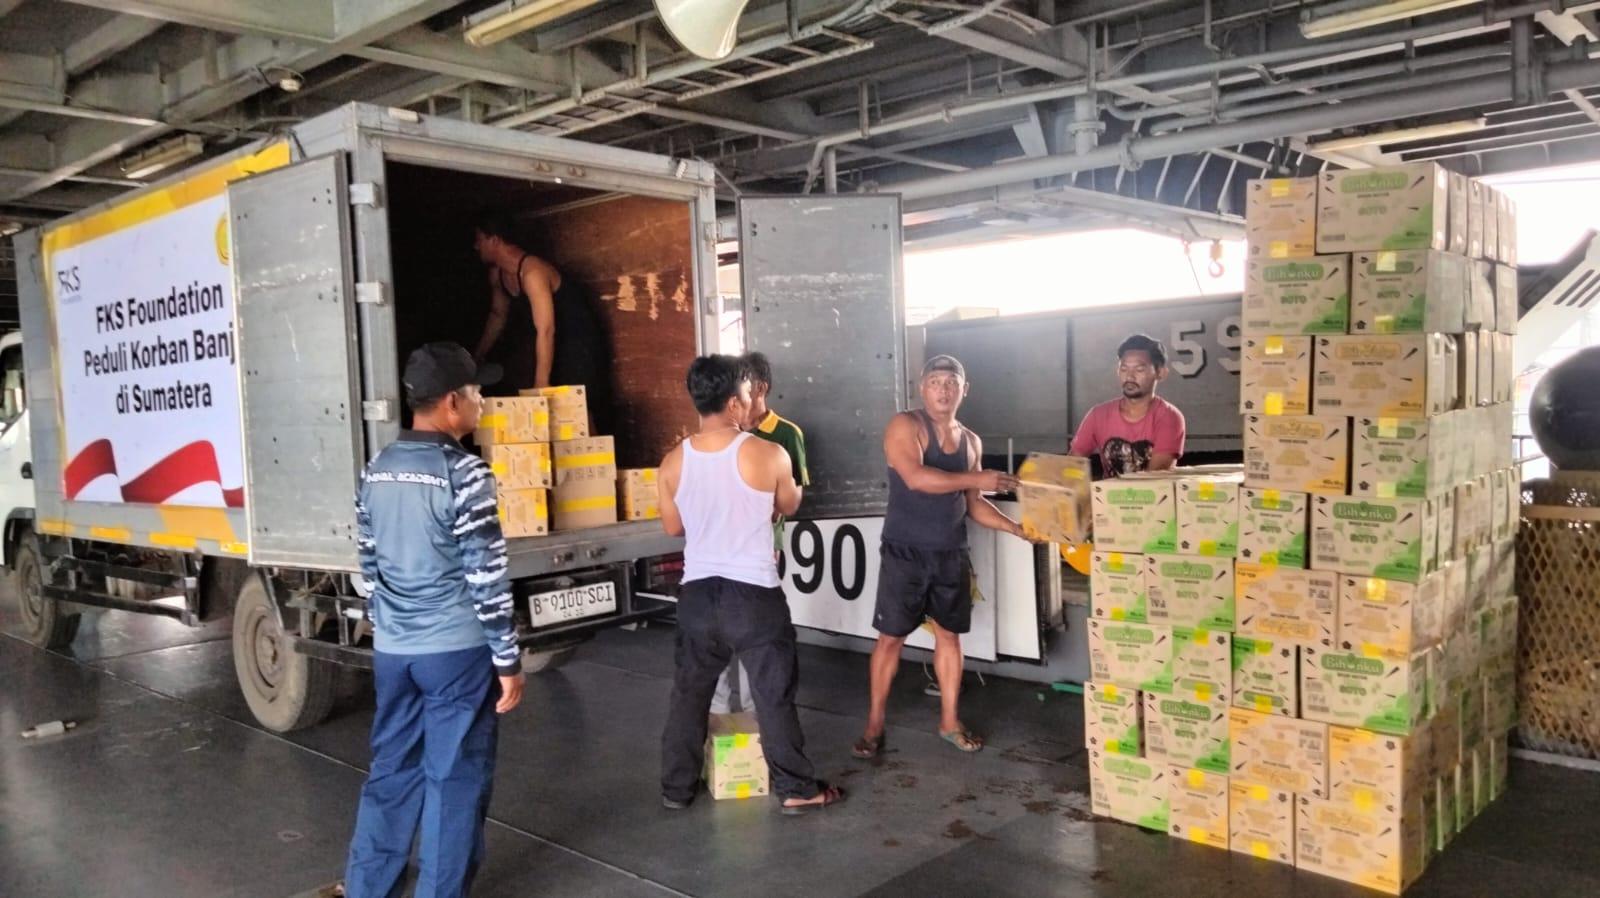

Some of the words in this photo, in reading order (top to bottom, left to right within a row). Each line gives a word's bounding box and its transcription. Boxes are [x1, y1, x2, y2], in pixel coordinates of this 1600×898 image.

[96, 301, 125, 333] FKS
[128, 280, 224, 327] Foundation
[84, 342, 128, 376] Peduli
[130, 335, 189, 370] Korban
[116, 384, 130, 414] di
[133, 380, 213, 413] Sumatera
[366, 472, 395, 483] NAVAL
[397, 472, 449, 488] ACADEMY
[778, 520, 867, 600] 90
[534, 599, 543, 615] B
[550, 589, 584, 611] 9100
[588, 584, 613, 604] SCI
